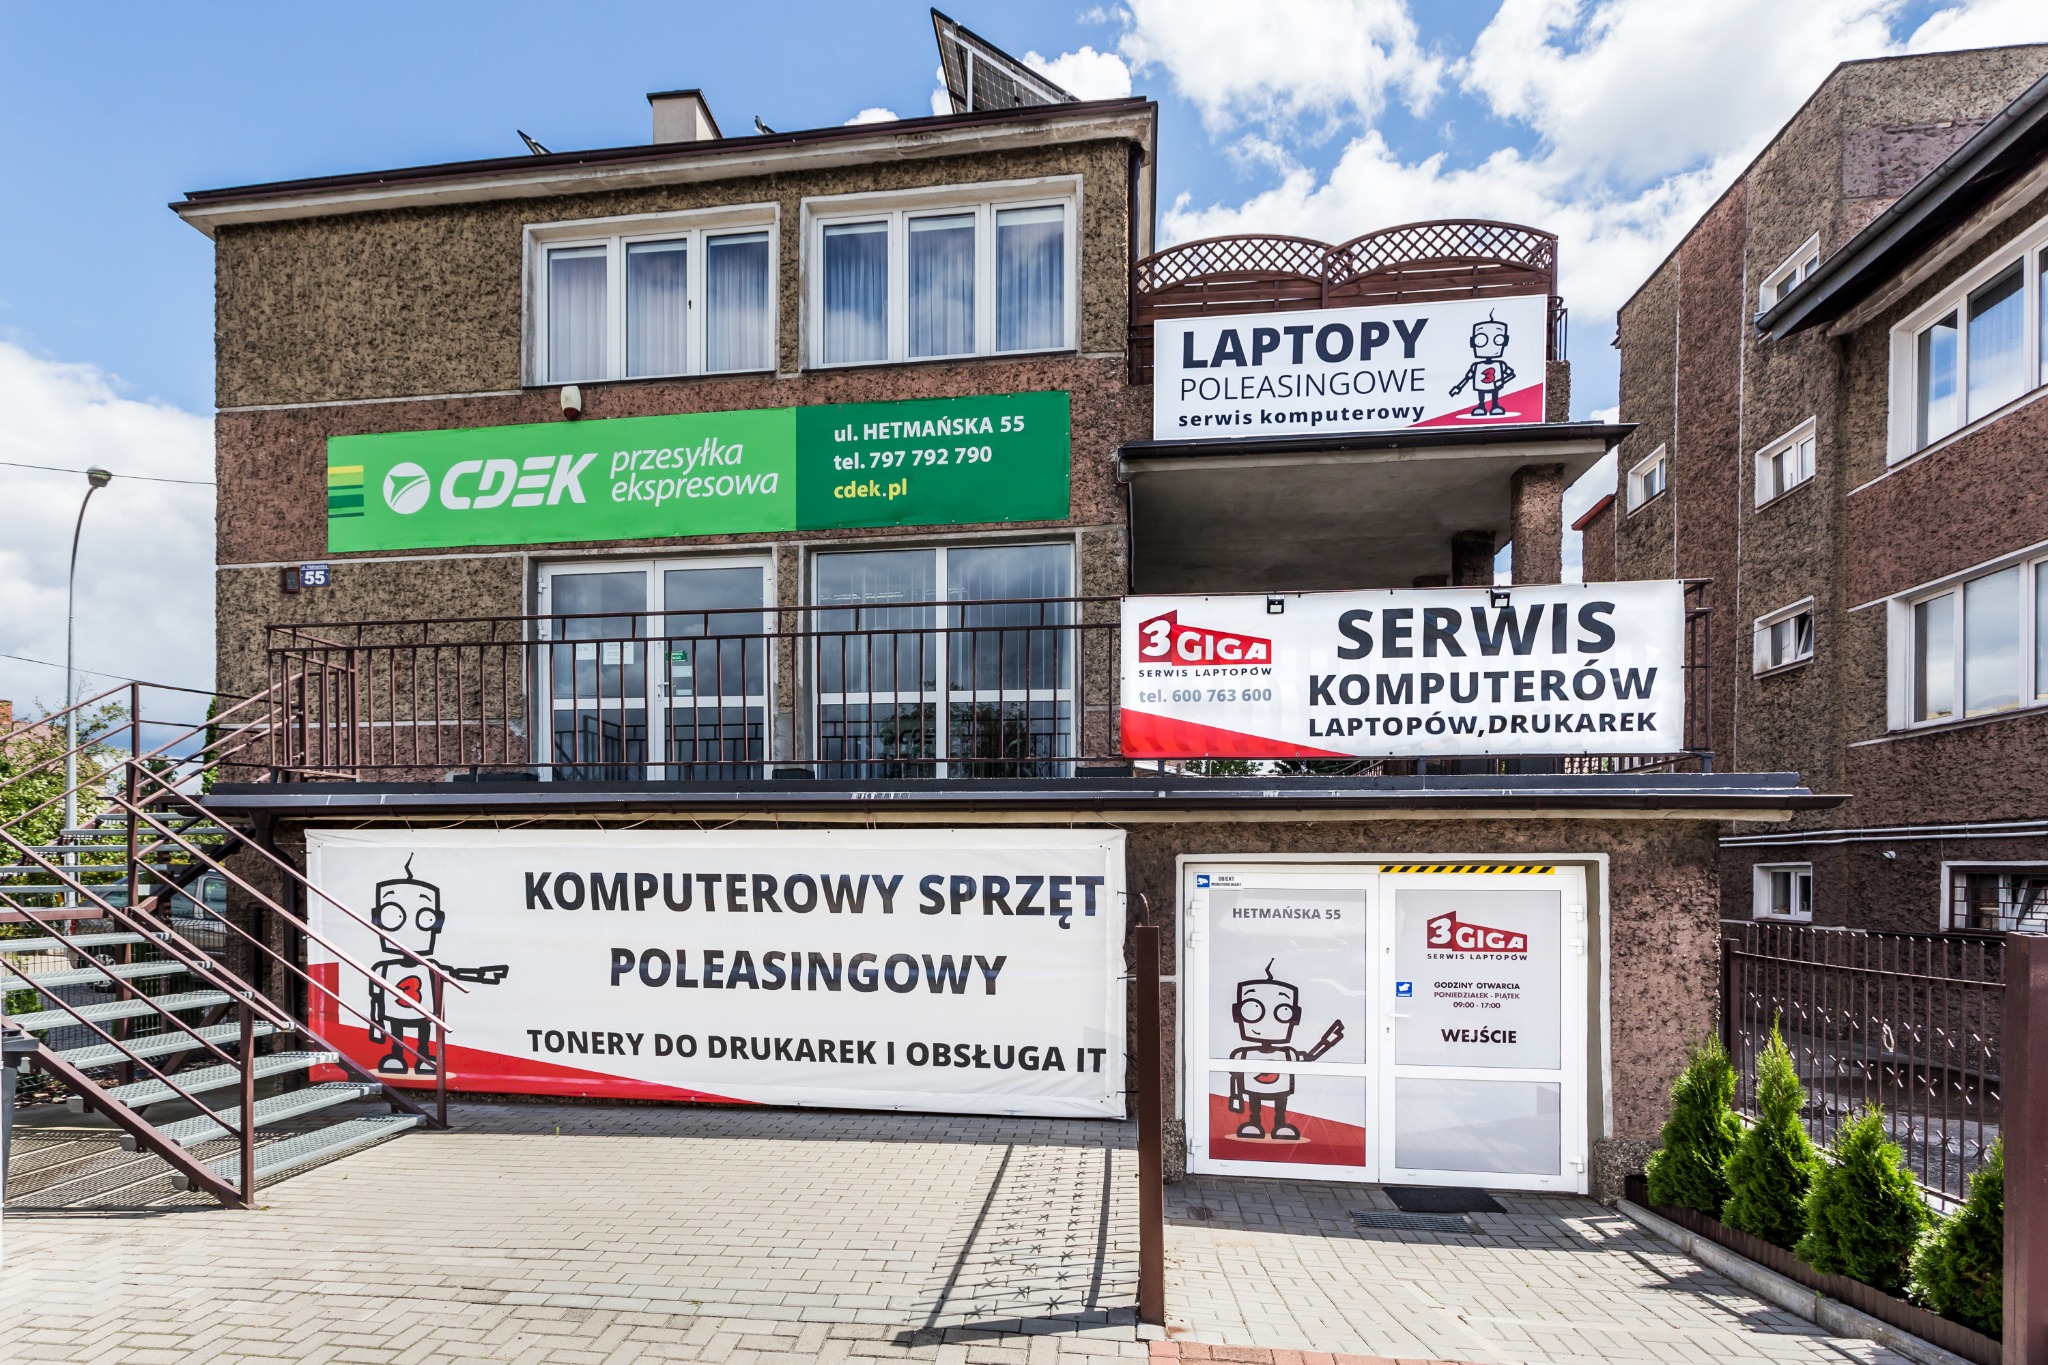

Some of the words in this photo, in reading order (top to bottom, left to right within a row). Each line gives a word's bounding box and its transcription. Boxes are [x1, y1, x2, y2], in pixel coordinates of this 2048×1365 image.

[1182, 318, 1429, 369] LAPTOPY
[1181, 367, 1426, 401] POLEASINGOWE
[1179, 408, 1253, 427] serwis
[1260, 404, 1425, 427] komputerowy
[834, 423, 858, 442] ul.
[863, 415, 994, 442] HETMAŃSKA
[1000, 415, 1025, 433] 55
[611, 438, 743, 479] przesyłka
[834, 452, 865, 470] tel.
[870, 450, 905, 468] 797
[912, 448, 948, 466] 792
[954, 446, 992, 464] 790
[440, 453, 598, 510] CDEK
[612, 471, 779, 507] ekspresowa
[834, 477, 907, 501] cdek.pl
[304, 570, 326, 585] 55
[1338, 600, 1616, 661] SERWIS
[1138, 669, 1188, 678] SERWIS
[1195, 666, 1273, 677] LAPTOPÓW
[1309, 658, 1658, 707] KOMPUTERÓW
[1138, 689, 1167, 703] tel.
[1172, 689, 1201, 703] 600
[1207, 689, 1237, 703] 763
[1241, 688, 1272, 702] 600
[525, 871, 905, 914] KOMPUTEROWY
[919, 874, 1105, 930] SPRZĘT
[1232, 906, 1321, 919] HETMAŃSKA
[1325, 909, 1341, 920] 55
[1470, 953, 1528, 961] LAPTOPÓW
[610, 947, 1008, 996] POLEASINGOWY
[1433, 981, 1473, 989] GODZINY
[1476, 982, 1521, 990] OTWARCIA
[1433, 991, 1489, 999] PONIEDZIAŁEK
[1495, 992, 1521, 1000] PIĄTEK
[1453, 1001, 1475, 1009] 09:00
[1441, 1025, 1517, 1044] WEJŚCIE
[527, 1029, 644, 1056] TONERY
[654, 1033, 698, 1058] DO
[708, 1035, 877, 1065] DRUKAREK
[887, 1041, 895, 1065] I
[906, 1041, 1066, 1072] OBSŁUGA
[1076, 1047, 1107, 1073] IT
